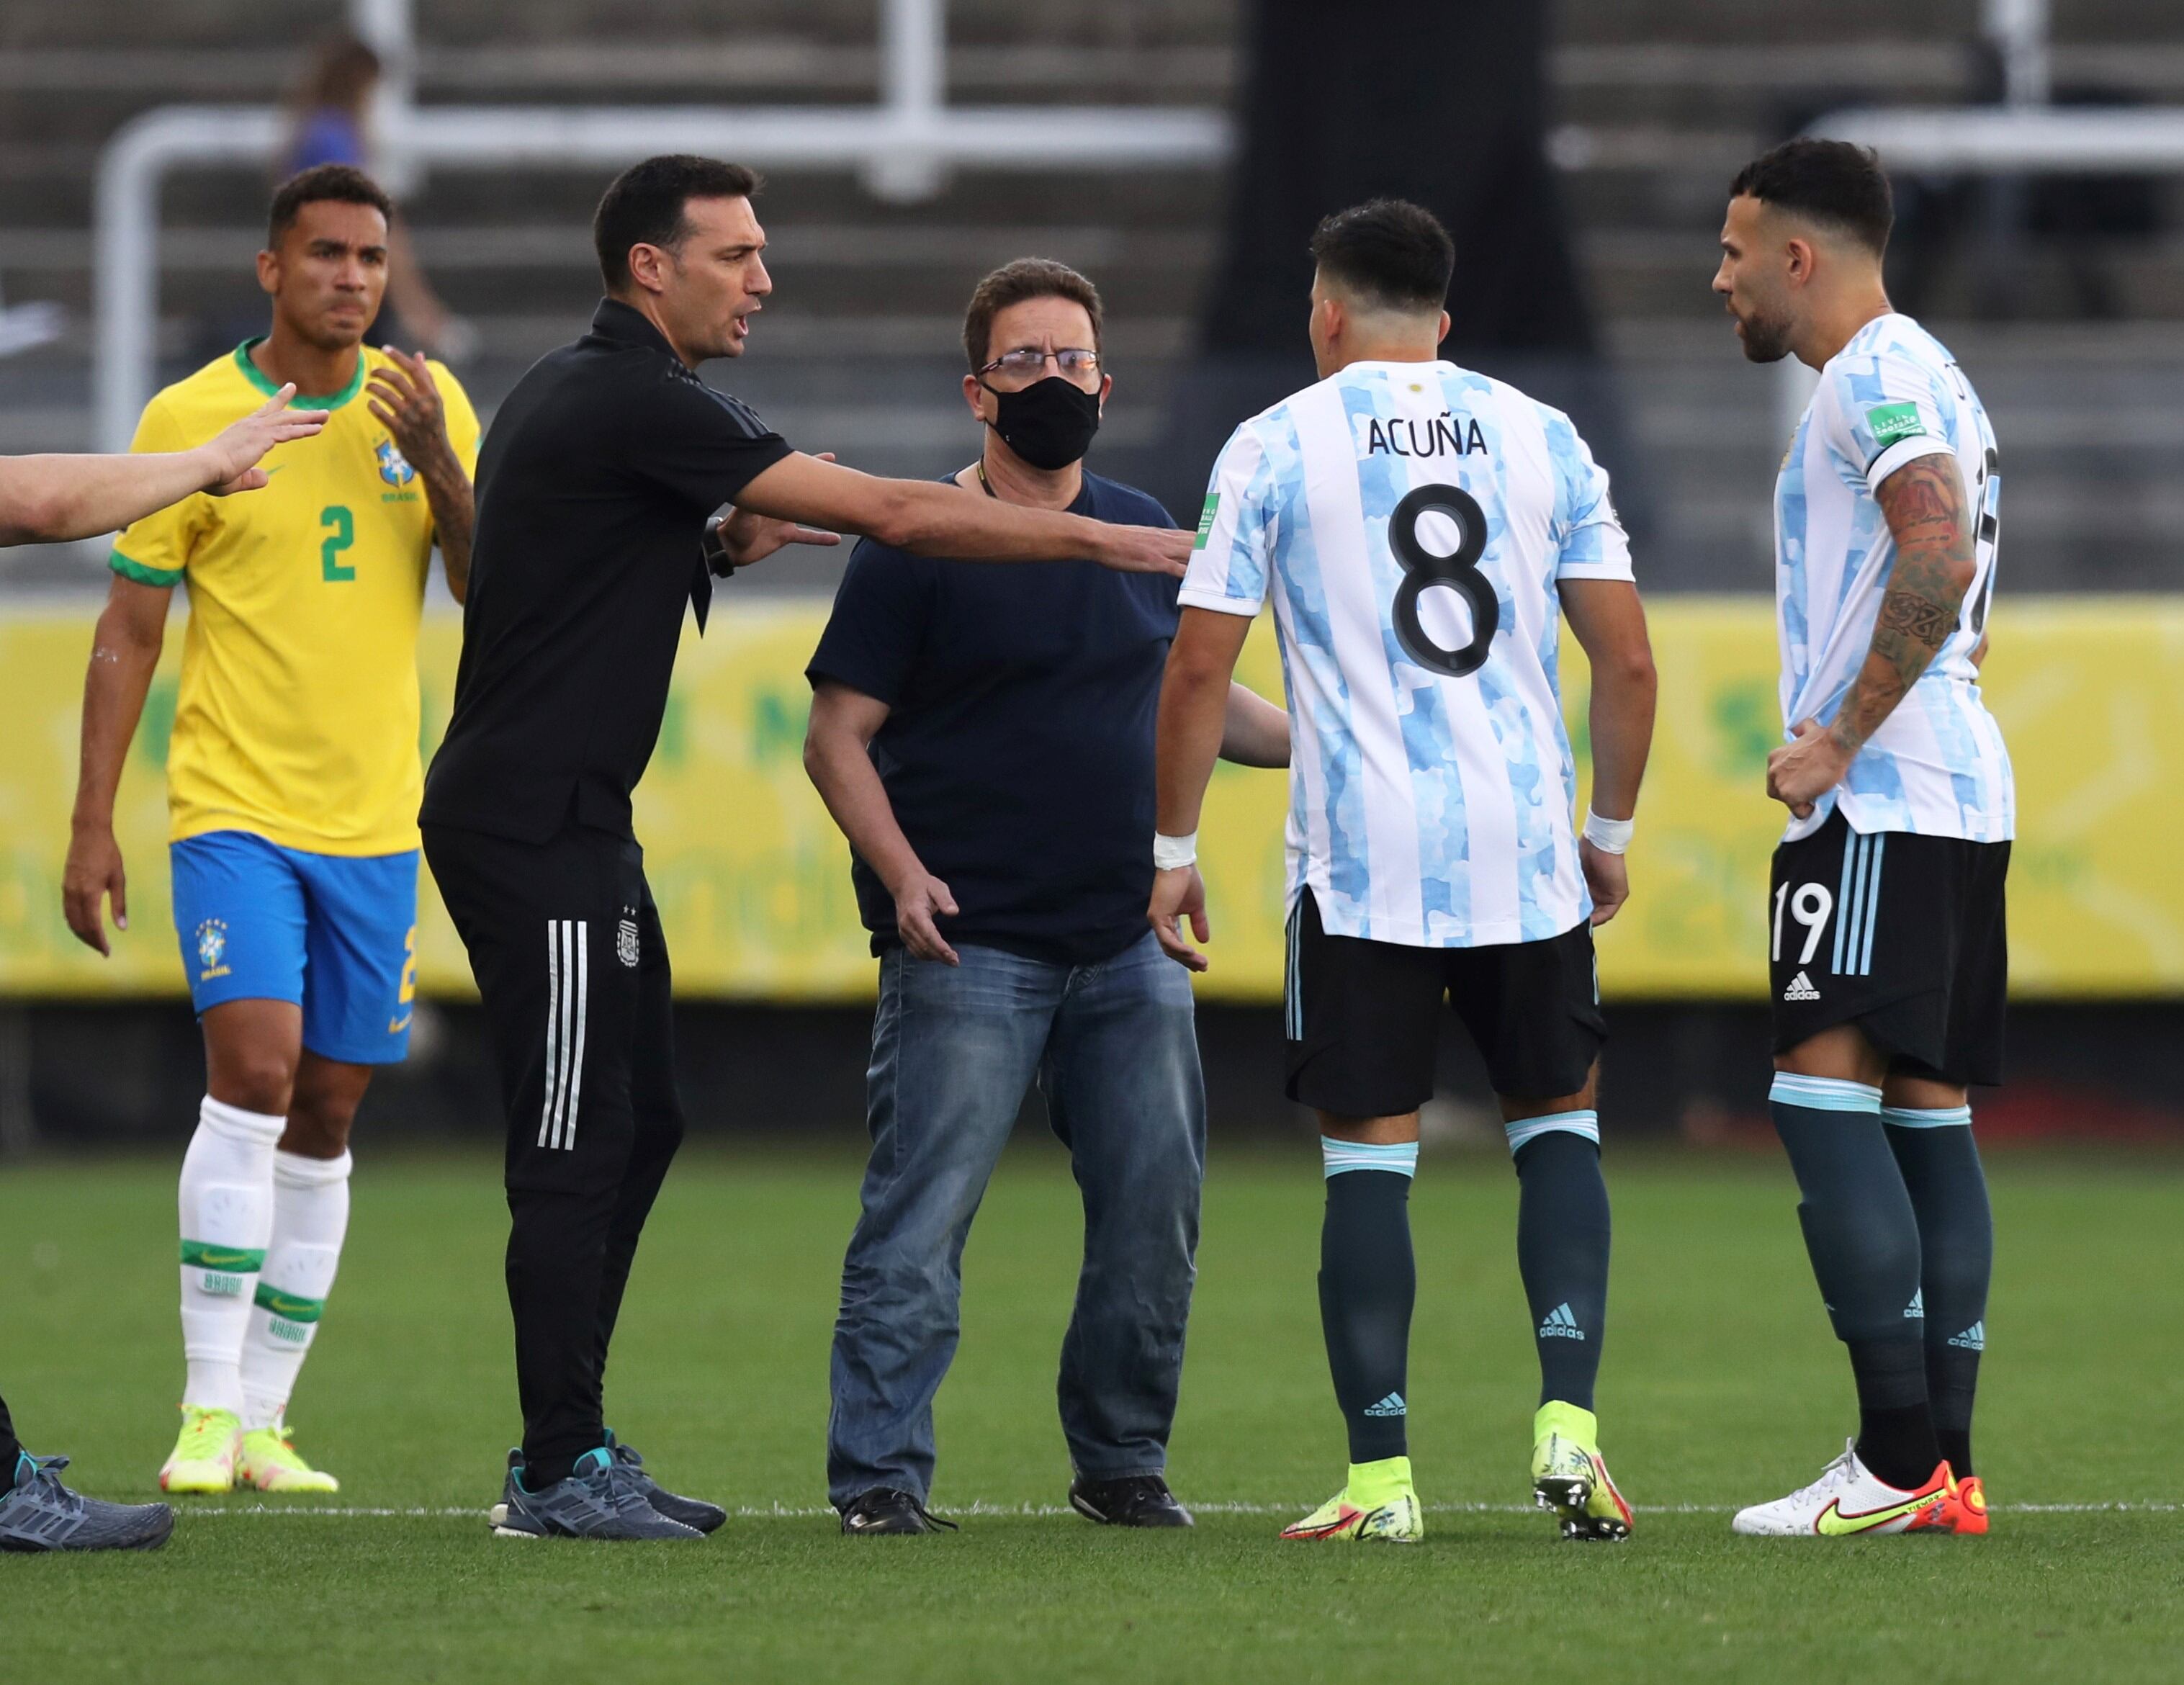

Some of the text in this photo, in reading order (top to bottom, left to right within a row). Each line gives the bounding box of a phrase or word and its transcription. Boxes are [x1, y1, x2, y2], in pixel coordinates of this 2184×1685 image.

[1369, 411, 1487, 457] ACUÑA
[320, 506, 356, 583] 2
[1388, 483, 1500, 678] 8
[1772, 881, 1833, 964] 19
[1784, 988, 1820, 1002] adidas
[1540, 1324, 1585, 1340] adidas
[1364, 1407, 1406, 1416] adida
